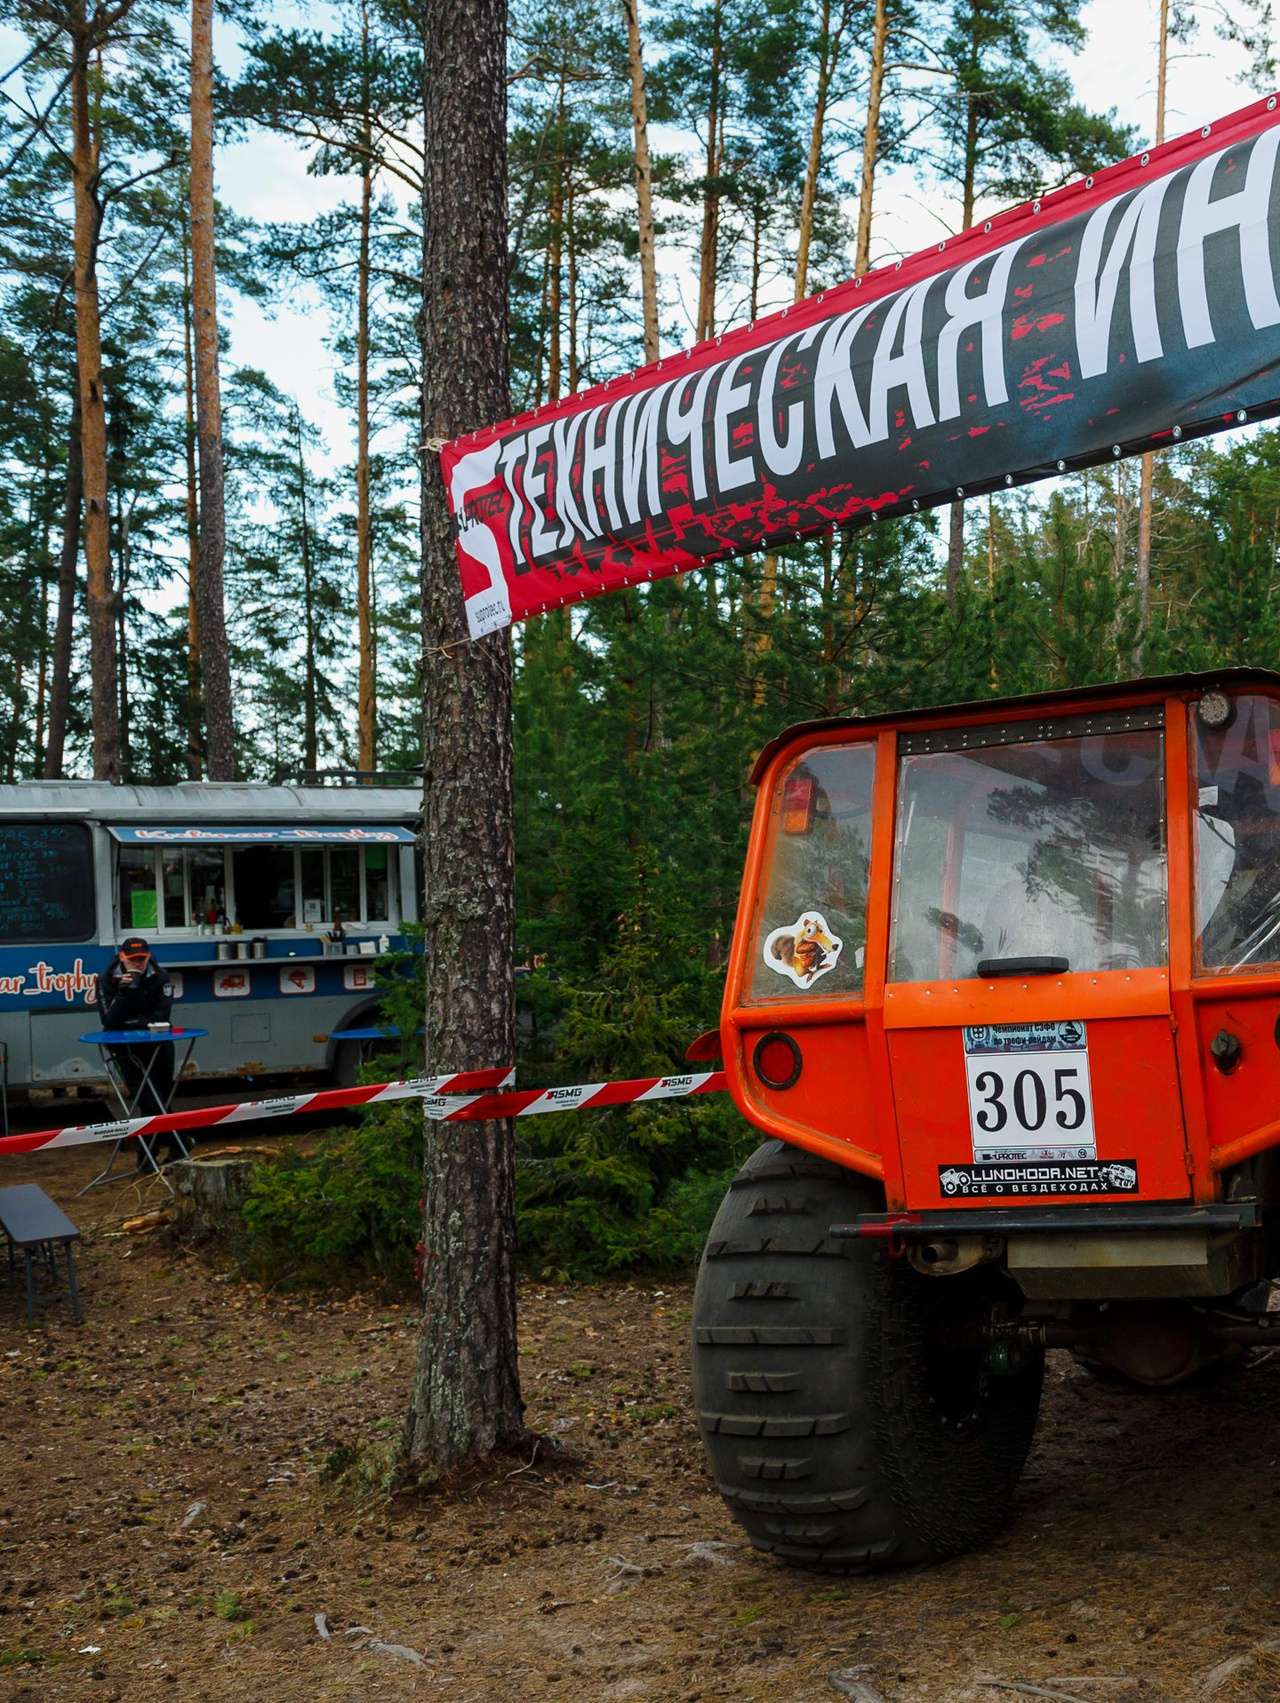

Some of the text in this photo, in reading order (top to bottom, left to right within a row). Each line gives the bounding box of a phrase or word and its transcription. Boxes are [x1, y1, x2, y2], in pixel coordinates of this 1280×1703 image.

[497, 228, 1042, 566] ТЕХНИЧЕСКАЯ
[992, 1022, 1055, 1034] Чемпионат СЗФО
[975, 1068, 1086, 1132] 305
[971, 1166, 1099, 1181] LUNOHODA.NET
[962, 1182, 1108, 1193] ВСЁ О ВЕЗДЕХОДАХ
